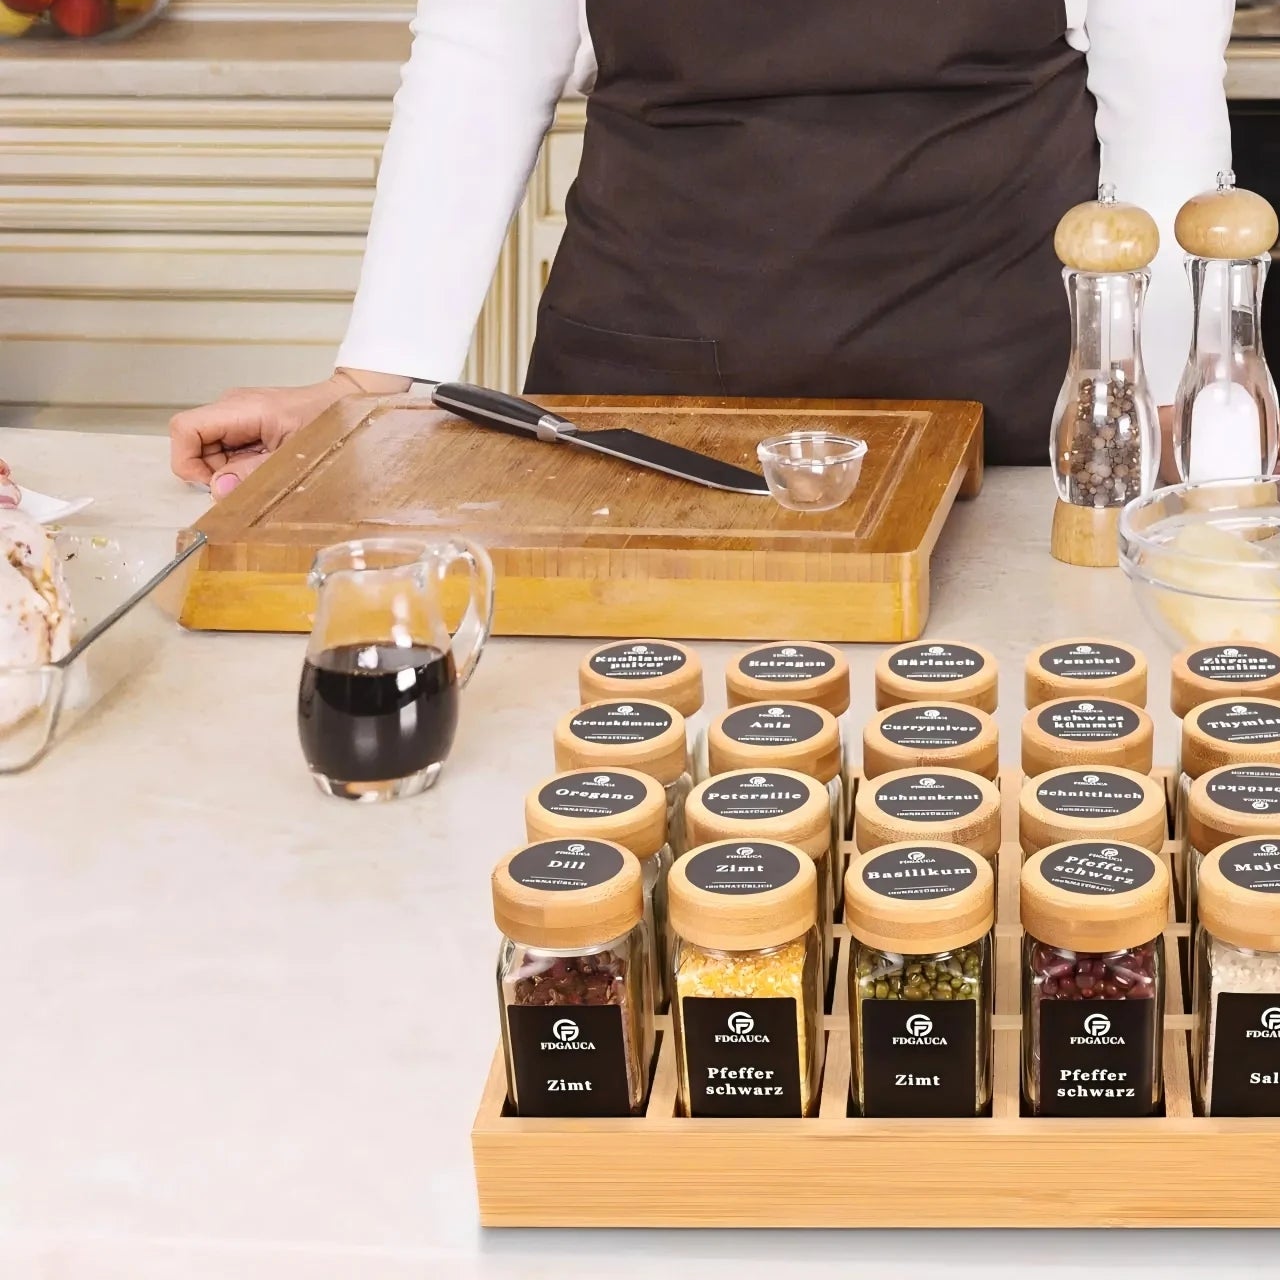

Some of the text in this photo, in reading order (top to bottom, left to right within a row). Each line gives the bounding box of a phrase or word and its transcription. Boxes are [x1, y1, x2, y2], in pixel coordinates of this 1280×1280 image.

[610, 661, 664, 669] pulver
[750, 721, 791, 729] Anis
[882, 724, 976, 732] Currypulver
[1054, 721, 1123, 729] kümmel
[555, 788, 634, 800] Oregano
[708, 792, 802, 800] Petersilie
[878, 793, 979, 801] Bohnenkraut
[1038, 789, 1142, 799] Schnittlauch
[546, 860, 586, 870] Dill
[716, 864, 764, 872] Zimt
[1064, 855, 1134, 874] Pfeffer
[867, 867, 972, 880] Basilikum
[1054, 864, 1135, 885] schwarz
[714, 1032, 770, 1043] FDGAUCA
[892, 1036, 948, 1045] FDGAUCA
[1070, 1034, 1126, 1045] FDGAUCA
[540, 1041, 596, 1050] FDGAUCA
[707, 1067, 774, 1080] Pfeffer
[1059, 1068, 1127, 1081] Pfeffer
[547, 1079, 593, 1091] Zimt
[895, 1073, 941, 1086] Zimt
[705, 1083, 784, 1096] schwarz
[1057, 1085, 1135, 1098] schwarz
